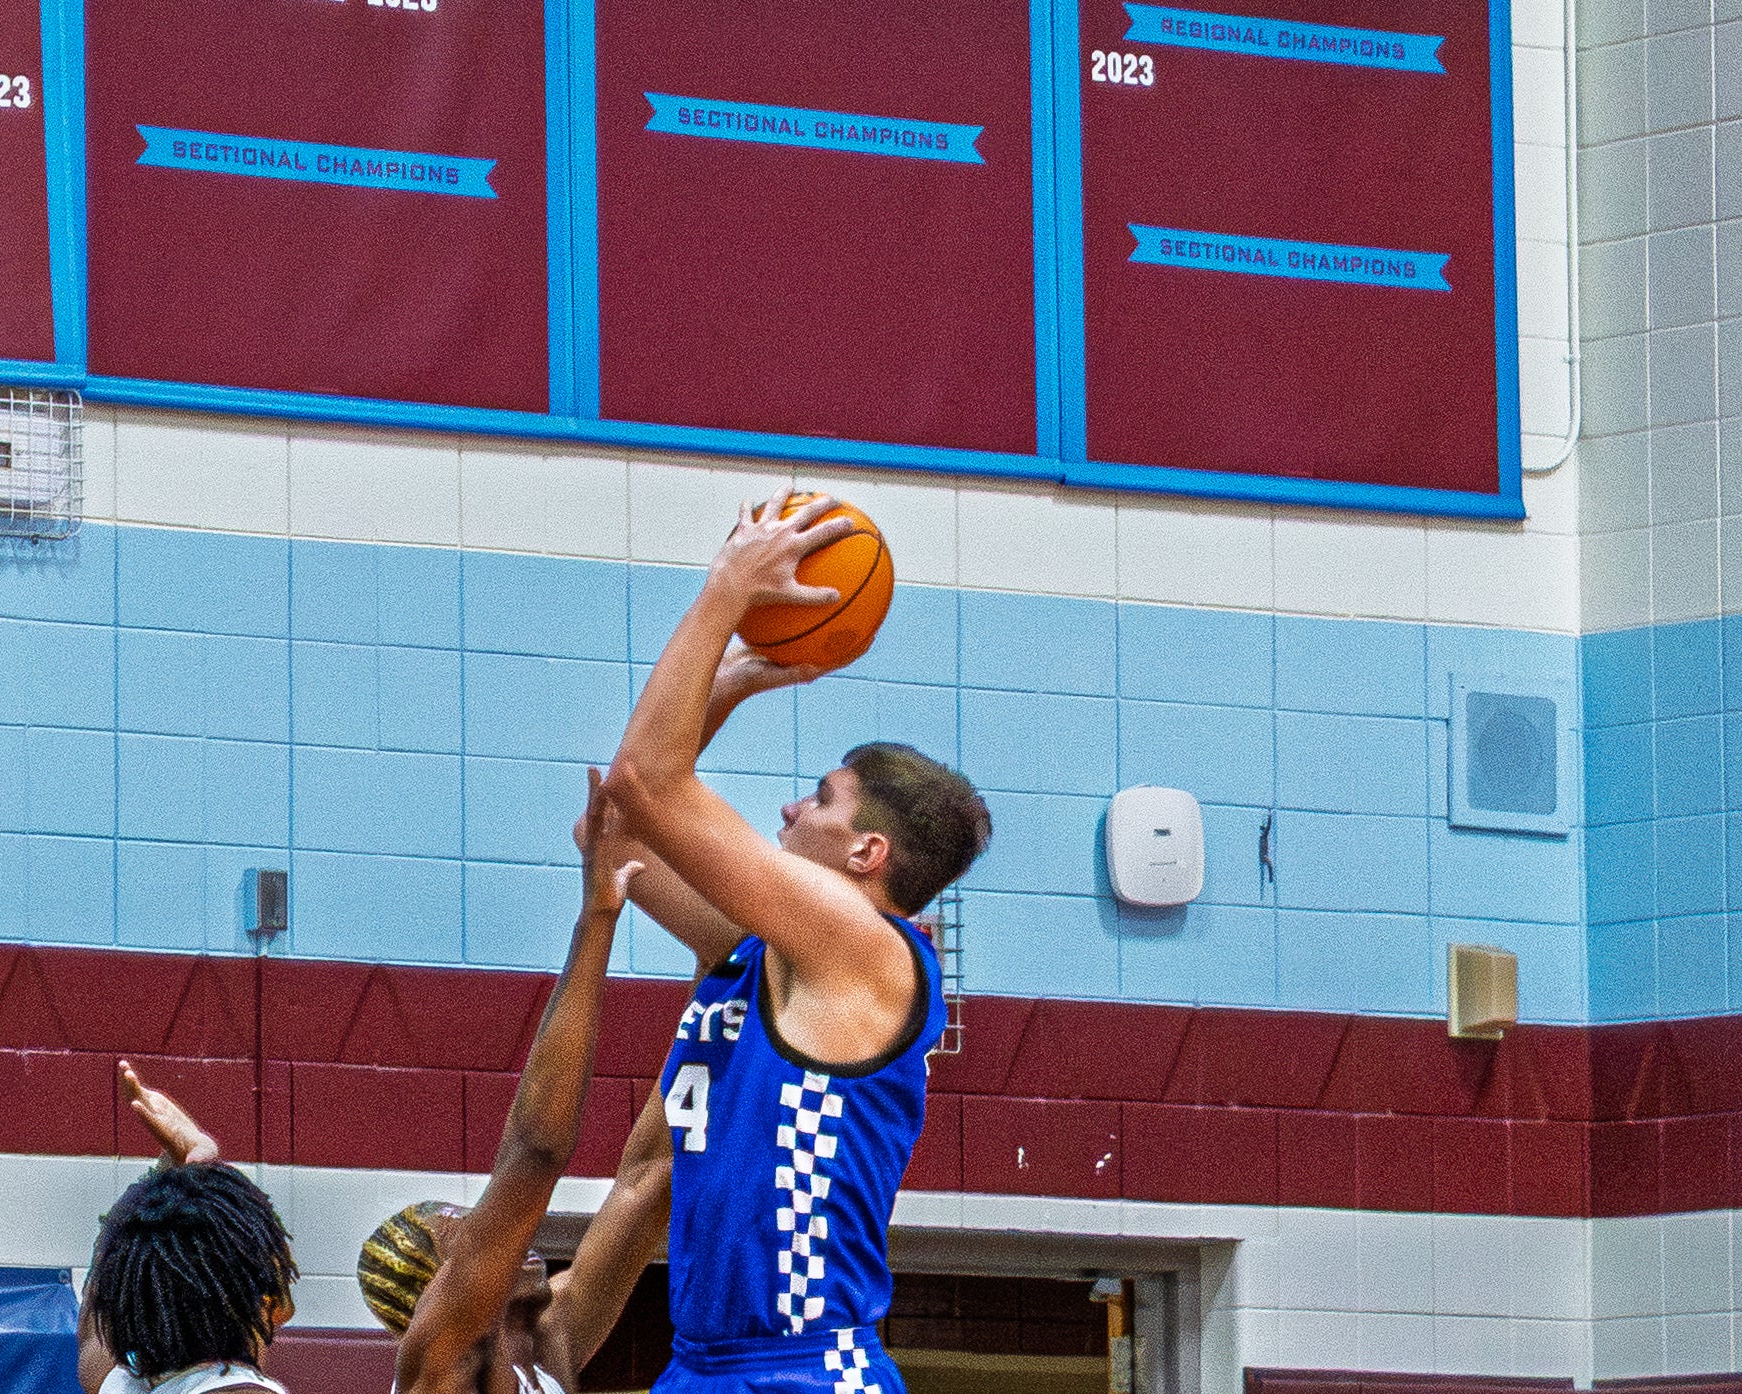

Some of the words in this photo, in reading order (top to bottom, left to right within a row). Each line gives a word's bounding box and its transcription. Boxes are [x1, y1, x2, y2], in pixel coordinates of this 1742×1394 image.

[1161, 18, 1268, 47] REGIONAL
[1277, 31, 1406, 61] CHAMPIONS
[1091, 49, 1155, 86] 2023
[678, 107, 806, 137] SECTIONAL
[814, 121, 949, 150] CHAMPIONS
[172, 140, 307, 171] SECTIONAL
[316, 154, 459, 184] CHAMPIONS
[1159, 238, 1279, 268] SECTIONAL
[1287, 251, 1417, 278] CHAMPIONS
